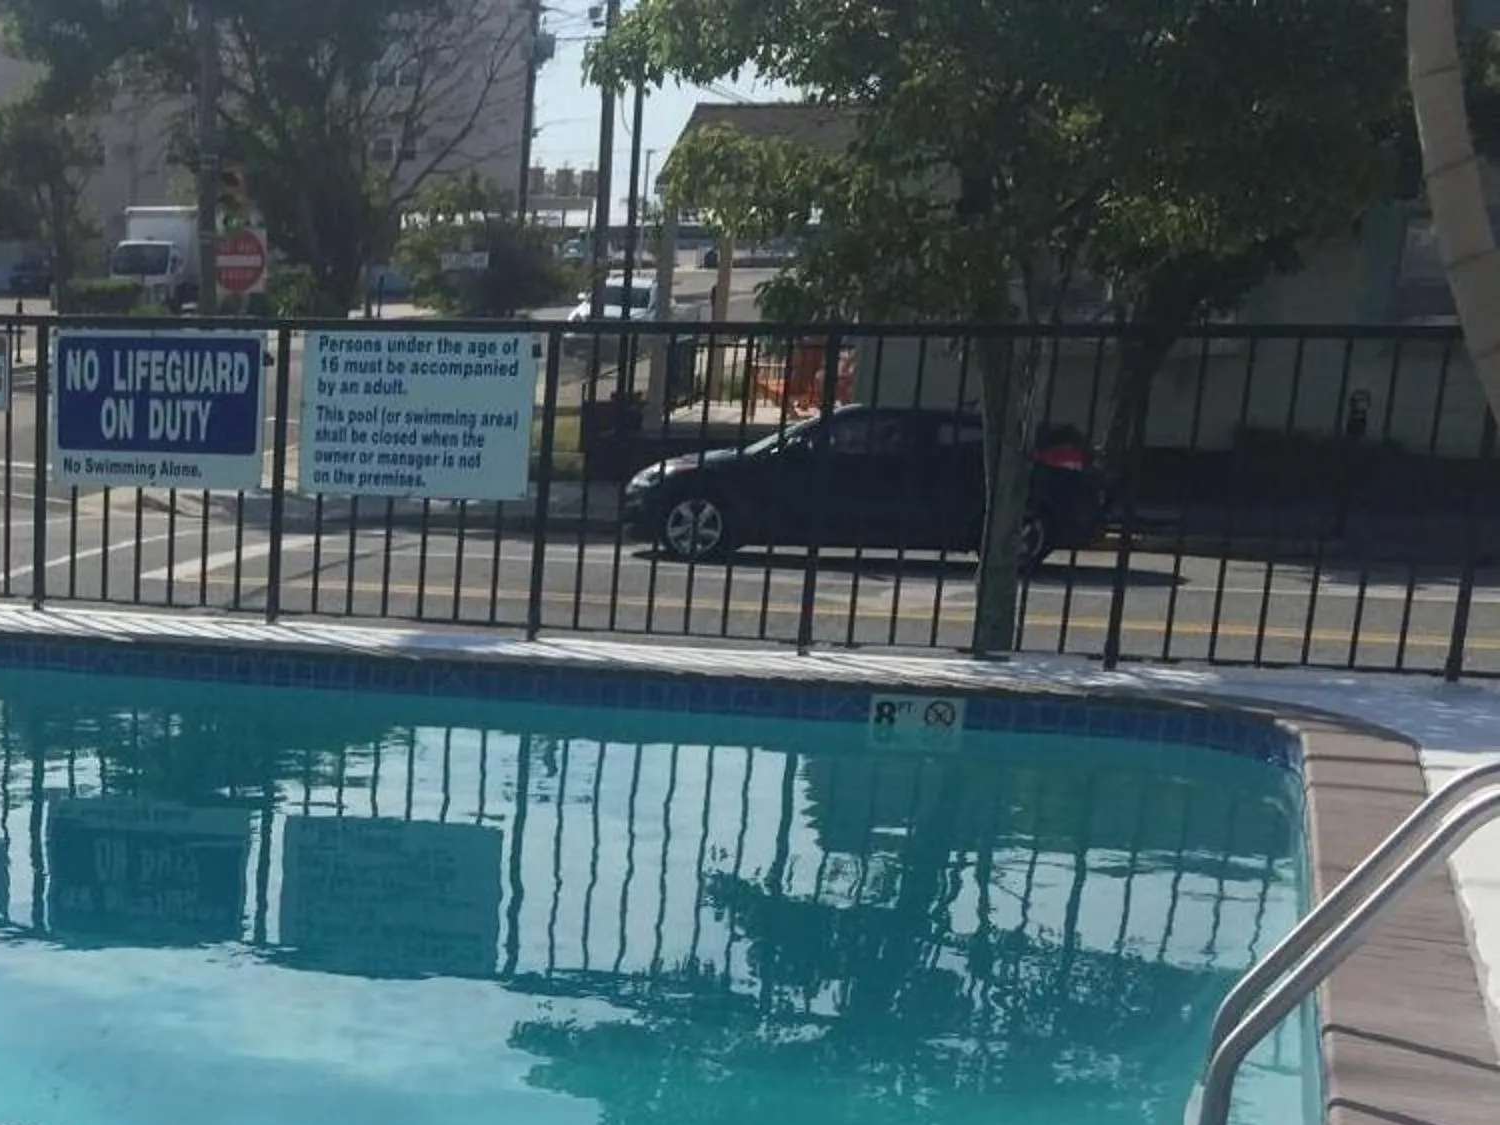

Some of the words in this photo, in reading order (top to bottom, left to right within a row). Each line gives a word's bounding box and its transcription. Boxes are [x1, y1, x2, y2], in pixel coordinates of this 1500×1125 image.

[319, 335, 382, 353] Persons
[388, 336, 432, 354] under
[438, 337, 463, 354] the
[468, 340, 497, 358] age
[503, 338, 519, 354] of
[66, 348, 99, 392] NO
[113, 350, 250, 394] LIFEGUARD
[320, 356, 339, 373] 16
[344, 358, 382, 374] must
[387, 358, 406, 375] be
[410, 359, 519, 379] accompanied
[317, 378, 336, 396] by
[340, 380, 359, 394] an
[364, 379, 408, 396] adult.
[101, 397, 135, 440] ON
[148, 399, 213, 442] DUTY
[316, 405, 344, 423] This
[348, 408, 377, 426] pool
[381, 406, 402, 428] (or
[405, 408, 476, 429] swimming
[481, 411, 518, 431] area)
[315, 426, 347, 442] shall
[351, 428, 367, 443] be
[371, 429, 417, 446] closed
[422, 431, 459, 447] when
[463, 431, 485, 448] the
[63, 456, 81, 473] No
[85, 457, 156, 480] Swimming
[160, 460, 203, 478] Alone.
[314, 451, 356, 464] owner
[359, 452, 375, 465] or
[377, 453, 437, 469] manager
[442, 452, 454, 467] is
[459, 453, 481, 469] not
[313, 470, 330, 483] on
[334, 469, 355, 484] the
[358, 470, 426, 488] premises.
